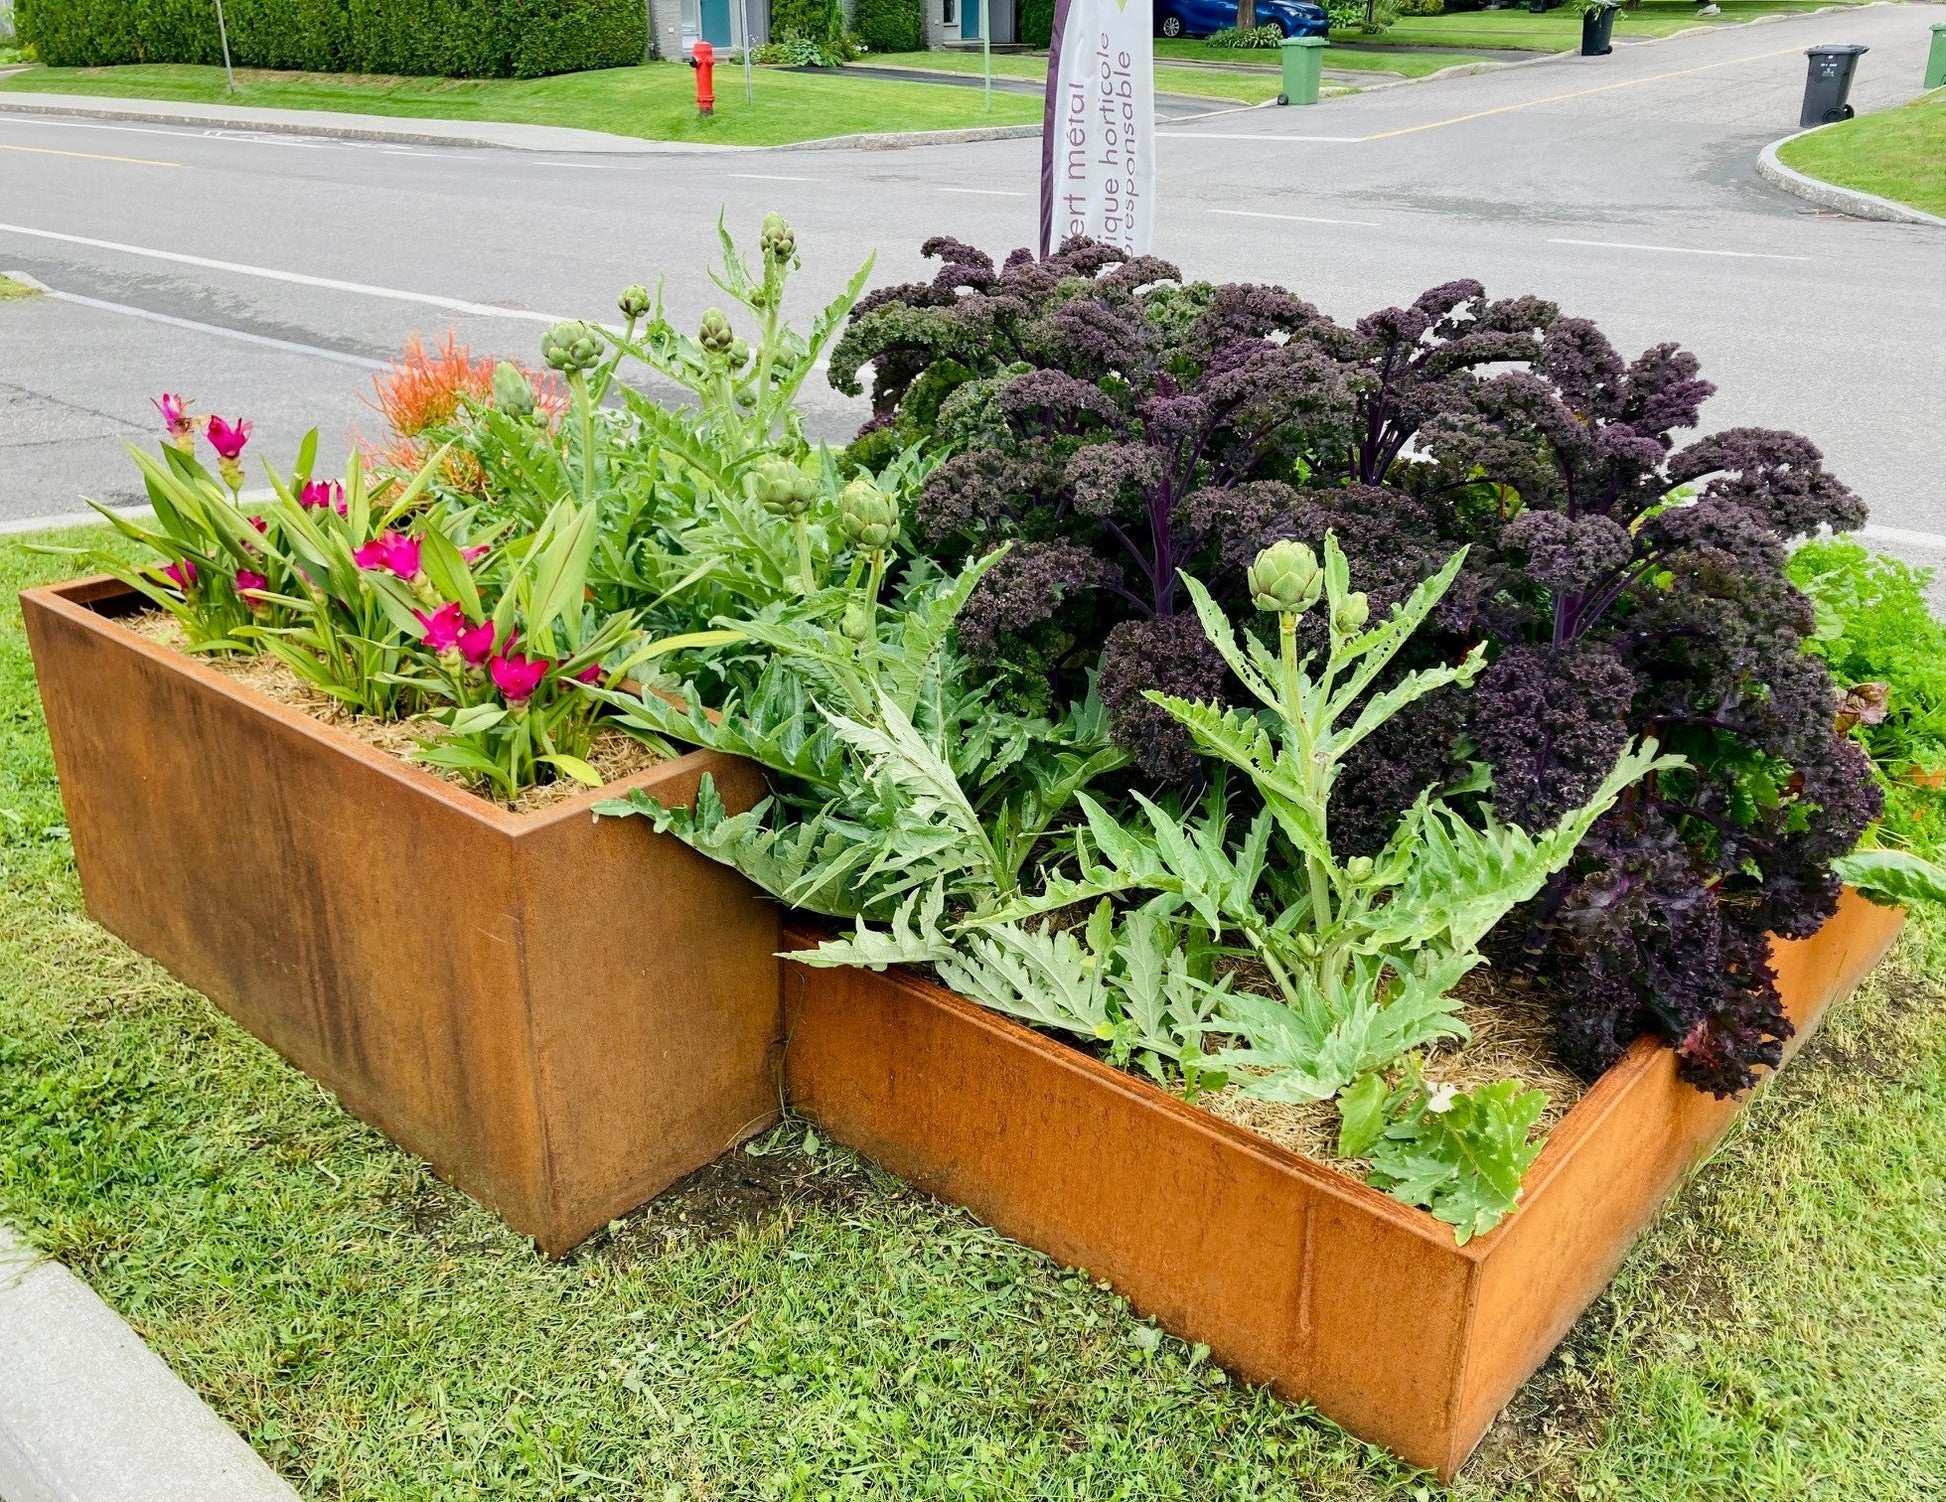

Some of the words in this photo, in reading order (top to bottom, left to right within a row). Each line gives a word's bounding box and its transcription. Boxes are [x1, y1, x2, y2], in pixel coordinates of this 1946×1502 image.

[1066, 82, 1086, 180] métal
[1096, 32, 1119, 166] horticole
[1113, 51, 1140, 258] oresponsable
